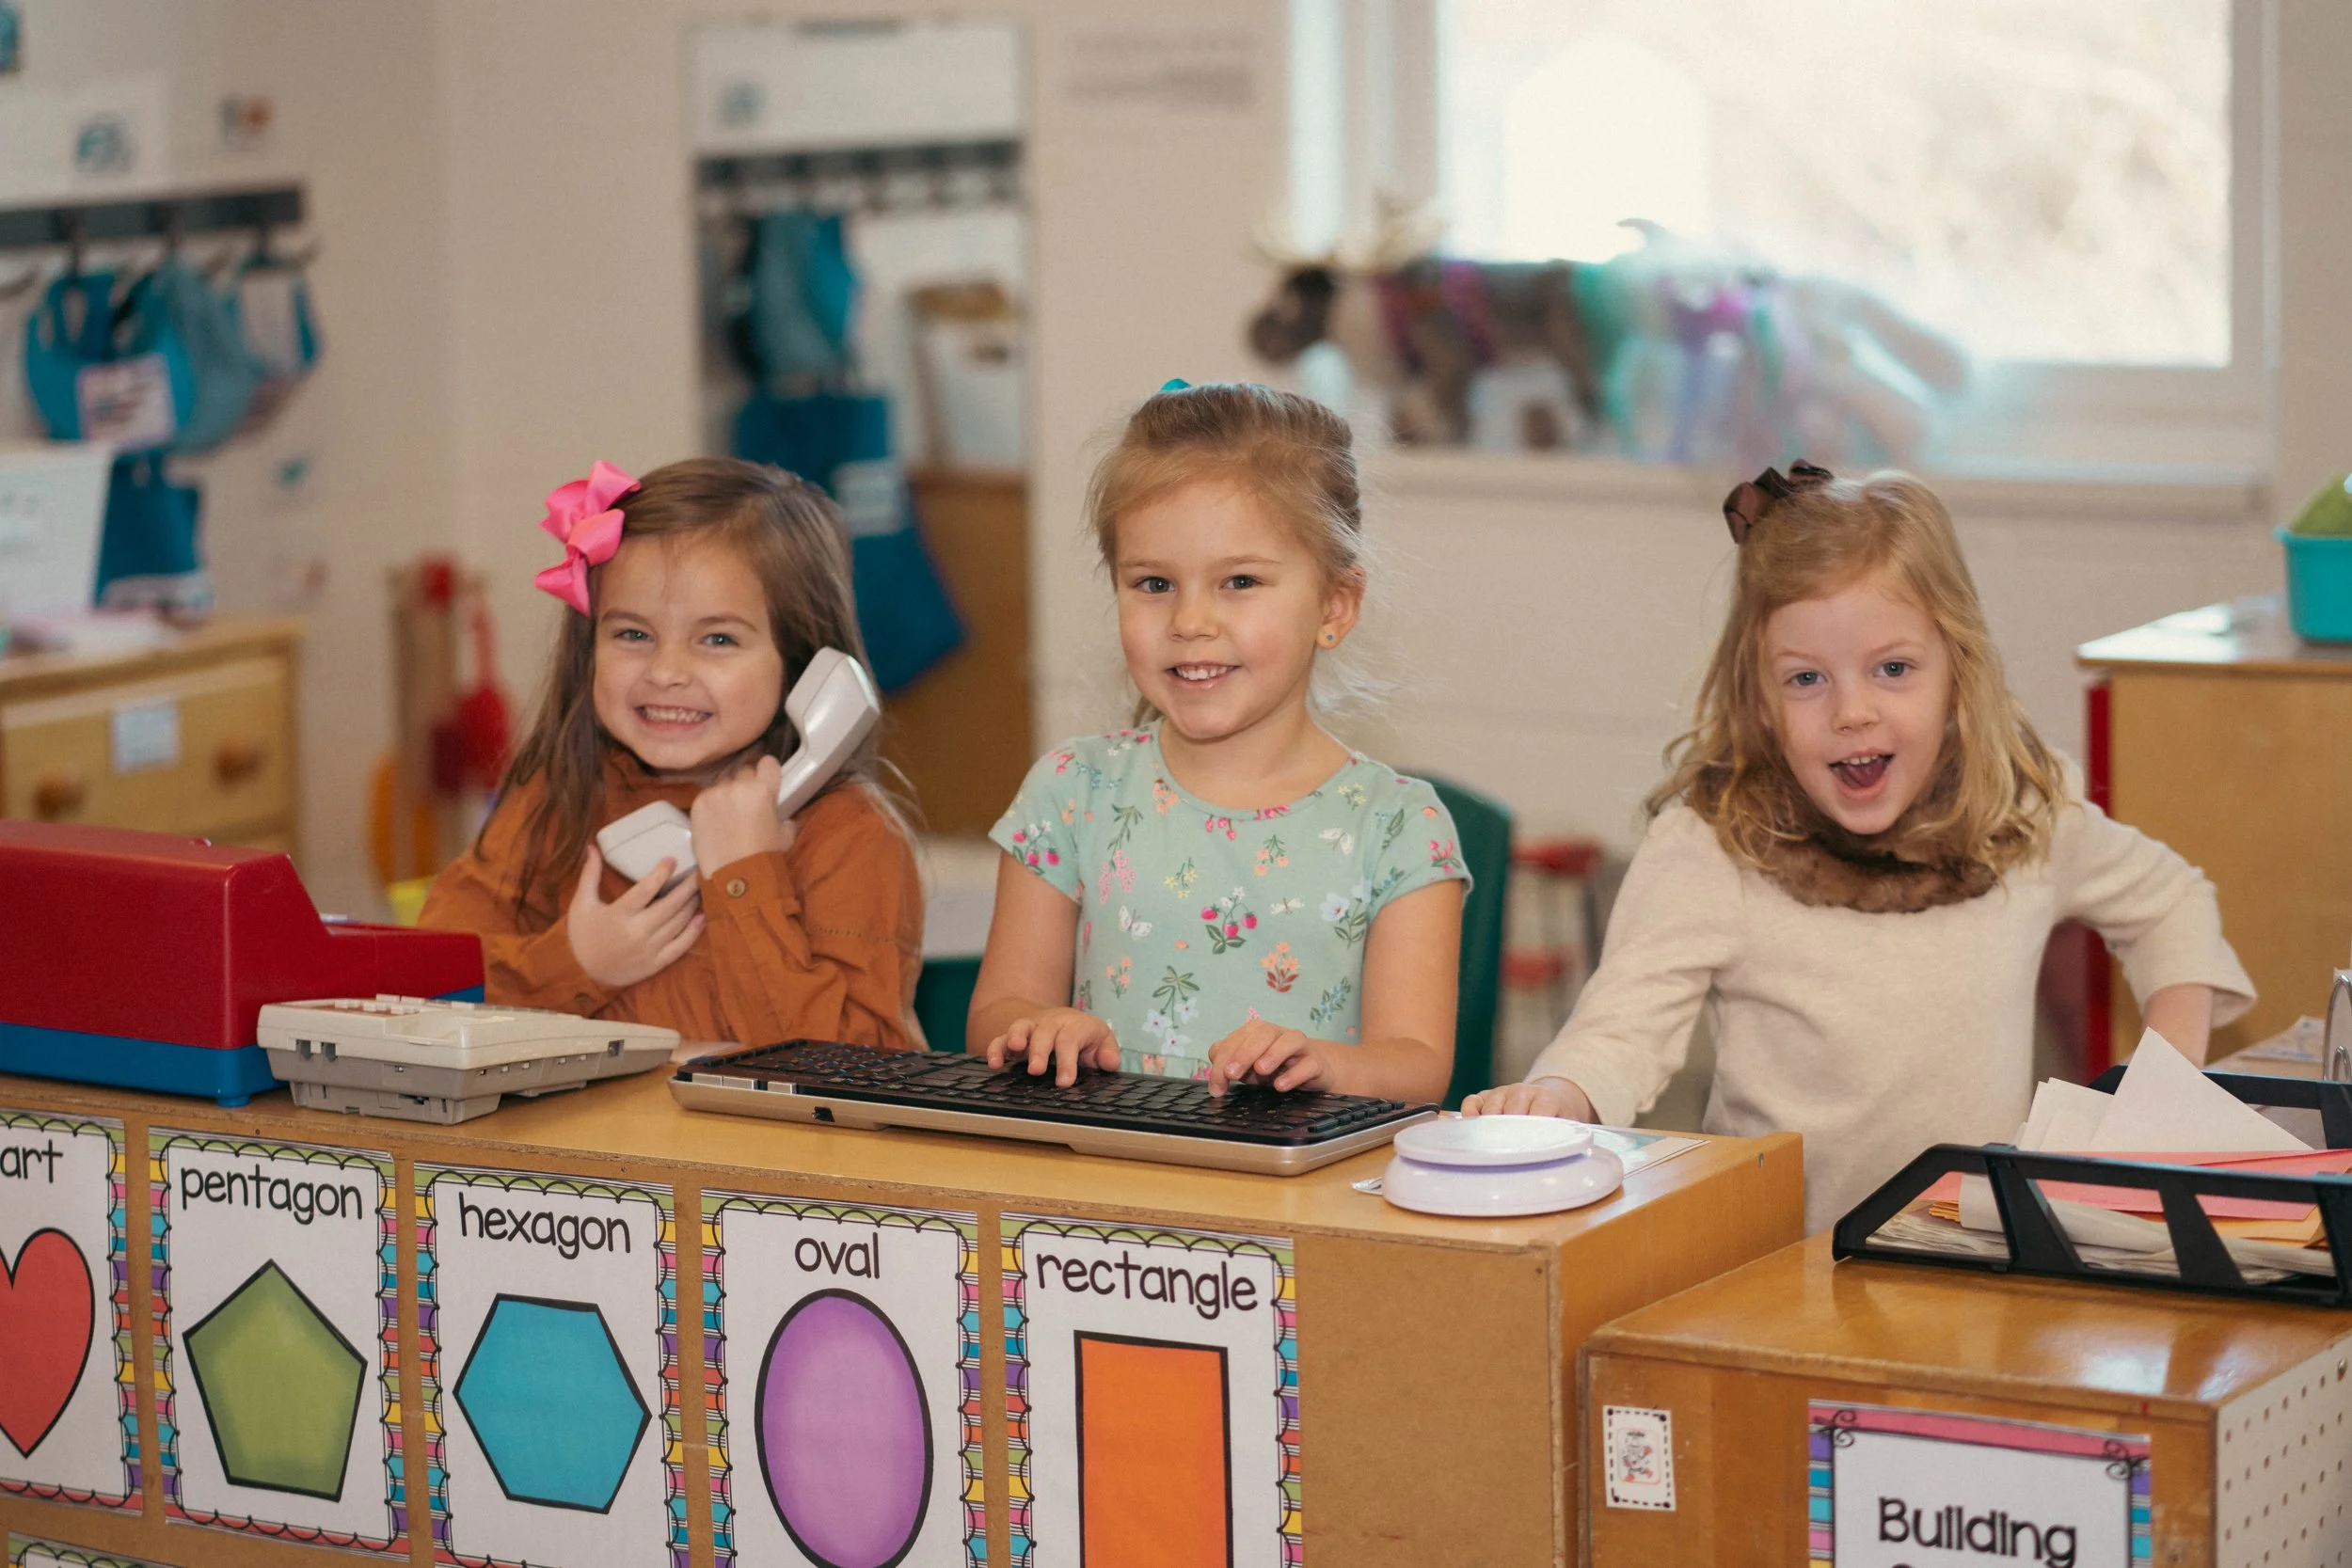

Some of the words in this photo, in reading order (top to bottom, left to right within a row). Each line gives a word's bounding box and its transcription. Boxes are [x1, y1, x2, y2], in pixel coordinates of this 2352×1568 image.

[0, 1139, 64, 1183] art
[180, 1164, 363, 1226] pentagon
[458, 1191, 631, 1260] hexagon
[794, 1231, 881, 1280] oval
[1036, 1250, 1258, 1321] rectangle
[1878, 1497, 2077, 1568] Building
